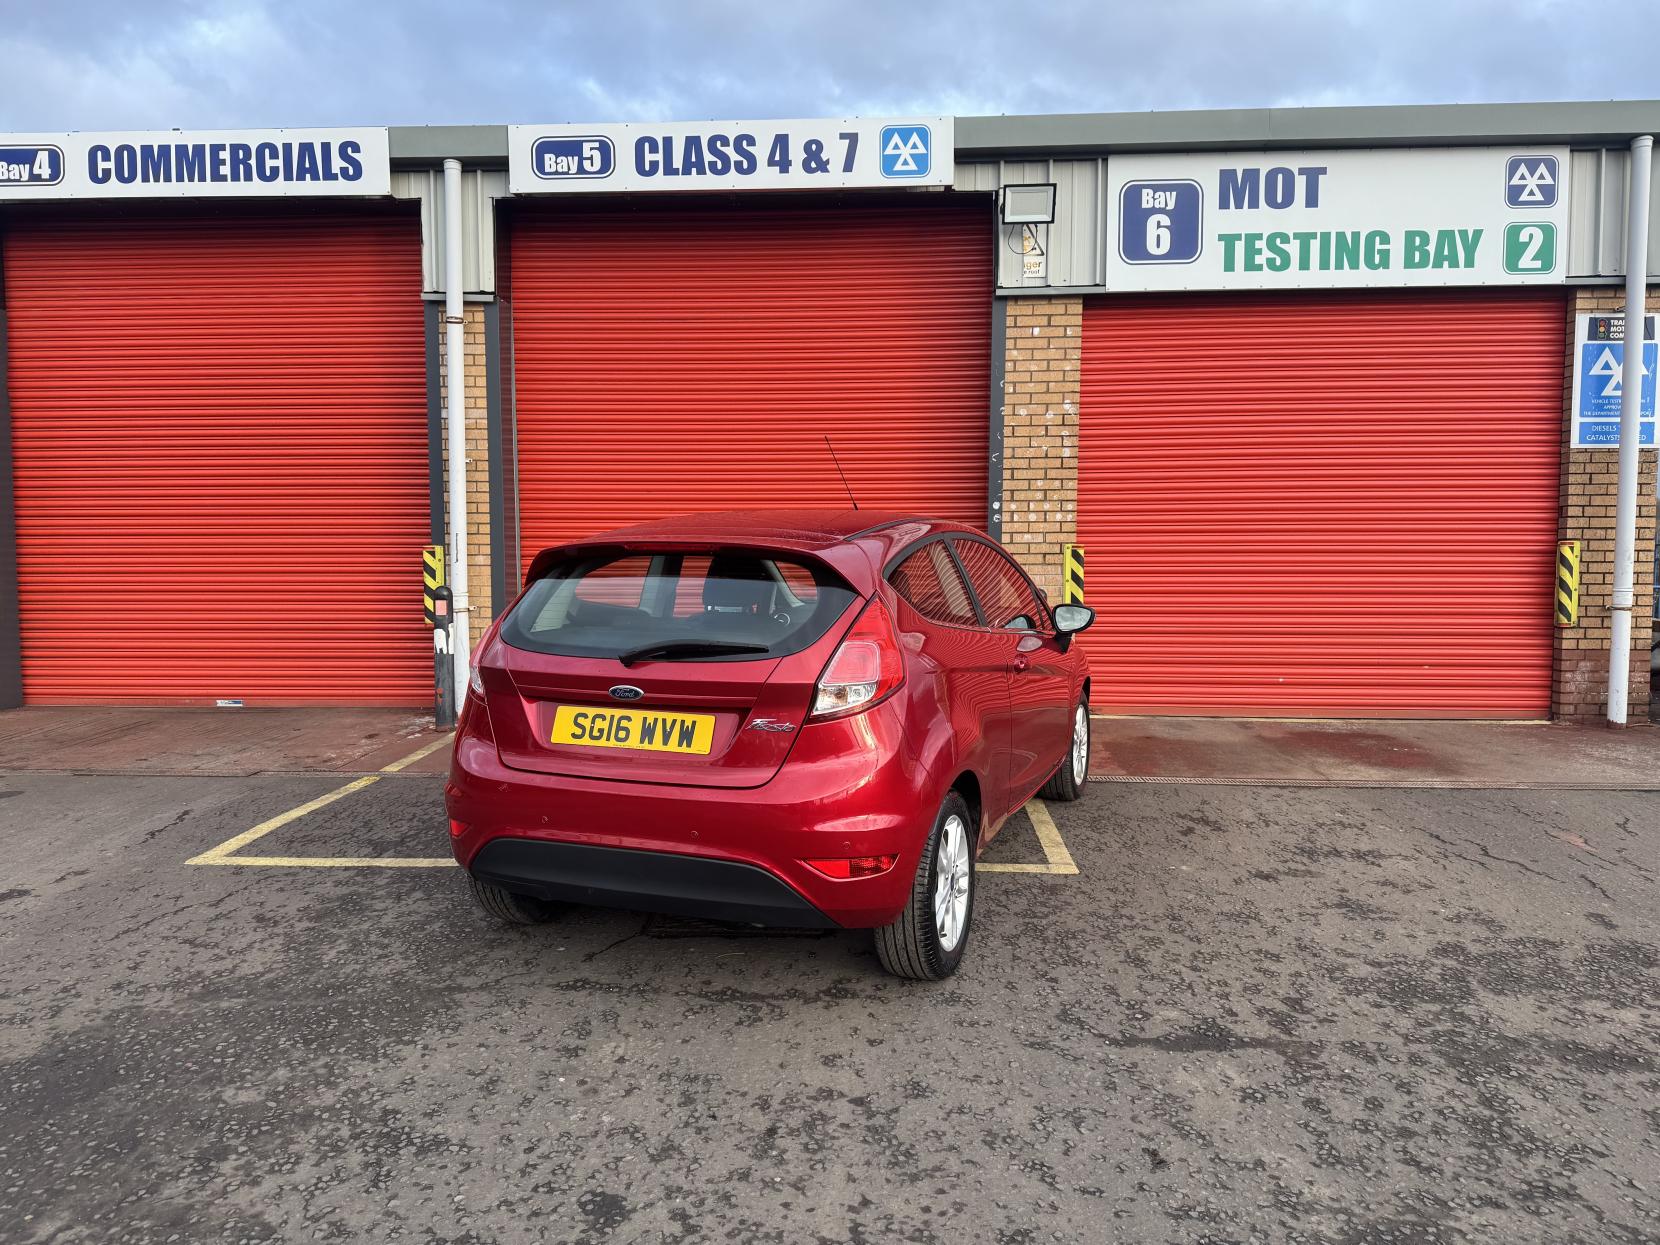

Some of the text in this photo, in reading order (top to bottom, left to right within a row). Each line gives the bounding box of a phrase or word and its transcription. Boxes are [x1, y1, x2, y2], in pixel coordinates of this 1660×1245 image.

[0, 150, 51, 181] Bay 4
[88, 140, 363, 185] COMMERCIALS
[544, 141, 601, 174] Bay 5
[634, 132, 860, 177] CLASS 4 & 7
[1141, 187, 1177, 211] Bay
[1218, 166, 1328, 210] MOT
[1146, 214, 1171, 256] 6
[1217, 228, 1484, 273] TESTING BAY
[1519, 226, 1542, 268] 2
[1023, 261, 1042, 270] ger
[571, 712, 697, 748] SG16 WVW
